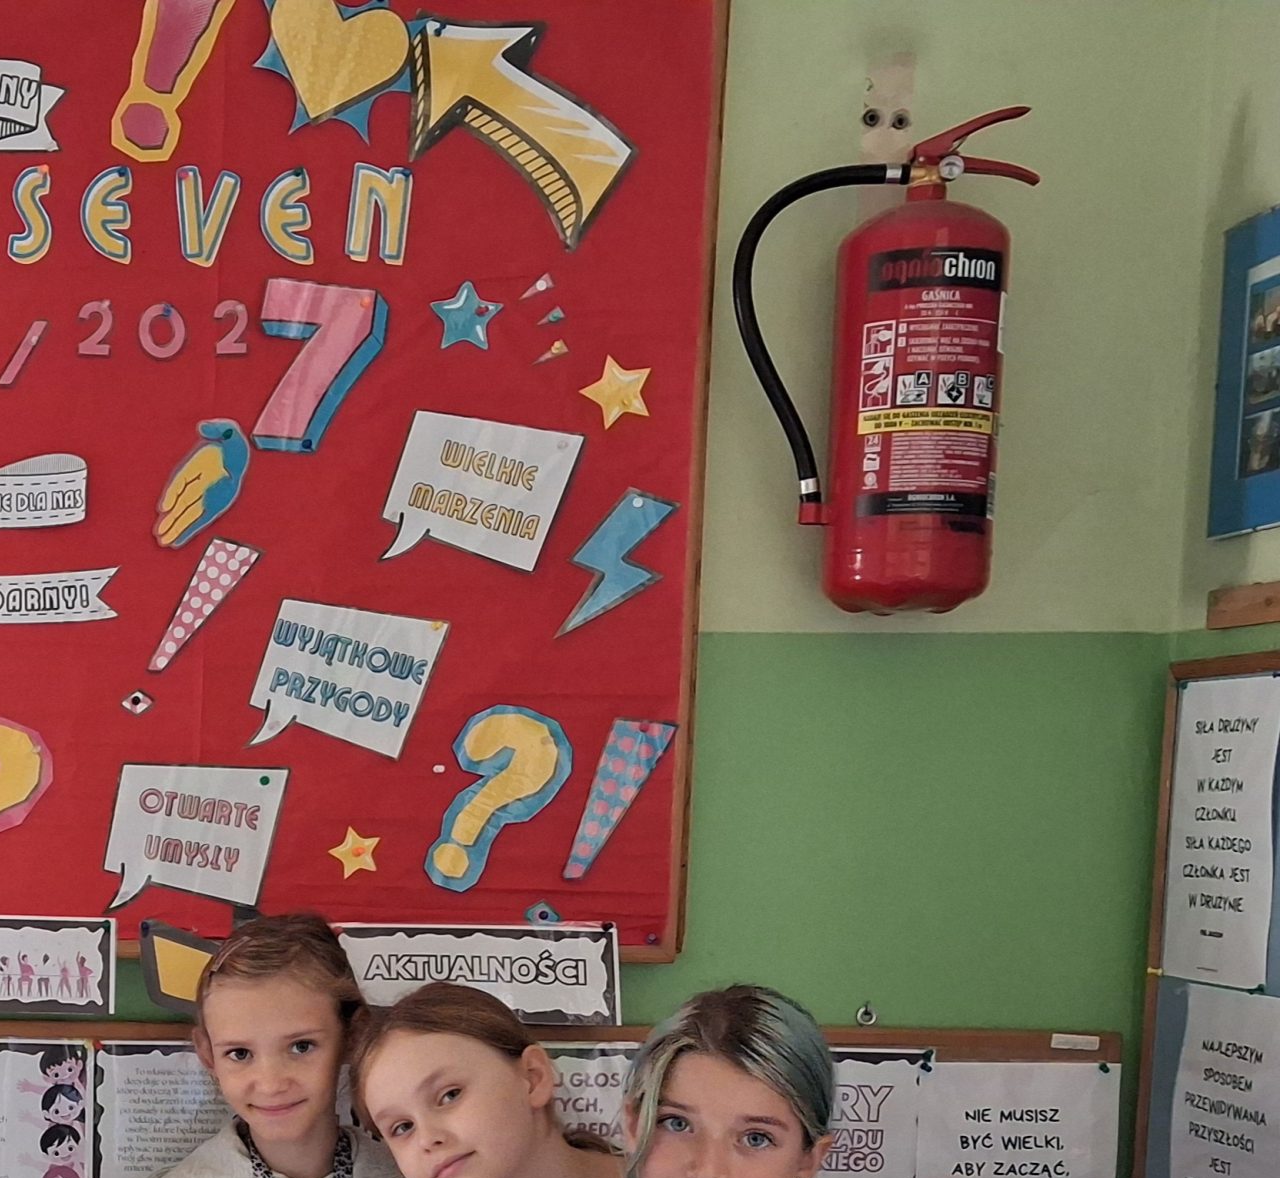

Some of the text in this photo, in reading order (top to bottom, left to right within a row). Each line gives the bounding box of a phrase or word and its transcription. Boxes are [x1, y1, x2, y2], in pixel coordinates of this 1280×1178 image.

[7, 163, 413, 267] SEVEN
[922, 289, 960, 301] GAŚNICA
[918, 373, 929, 385] A
[958, 373, 967, 385] B
[439, 439, 539, 491] WIELKIE
[16, 492, 47, 512] DLA
[50, 489, 84, 511] NAS
[407, 482, 541, 541] MARZENIA
[273, 619, 428, 685] WYJĄTKOWE
[269, 667, 410, 728] PRZYGODY
[1211, 748, 1232, 763] JEST
[1197, 778, 1205, 793] W
[139, 788, 260, 830] OTWARTE
[1229, 867, 1250, 882] JEST
[1188, 893, 1197, 909] W
[364, 950, 587, 986] AKTUALNOŚCI
[1202, 1040, 1263, 1064] NAJLEPSZYM
[1203, 1067, 1252, 1091] SPOSOBEM
[965, 1108, 1060, 1123] NIE MUSISZ
[1185, 1091, 1267, 1126] PRZEWIDYWANIA
[959, 1133, 1064, 1150] BYĆ WIELKI,
[1189, 1121, 1254, 1154] PRZYSZŁOŚCI
[951, 1161, 1070, 1178] ABY ZACZĄĆ,
[1209, 1157, 1231, 1176] JEST
